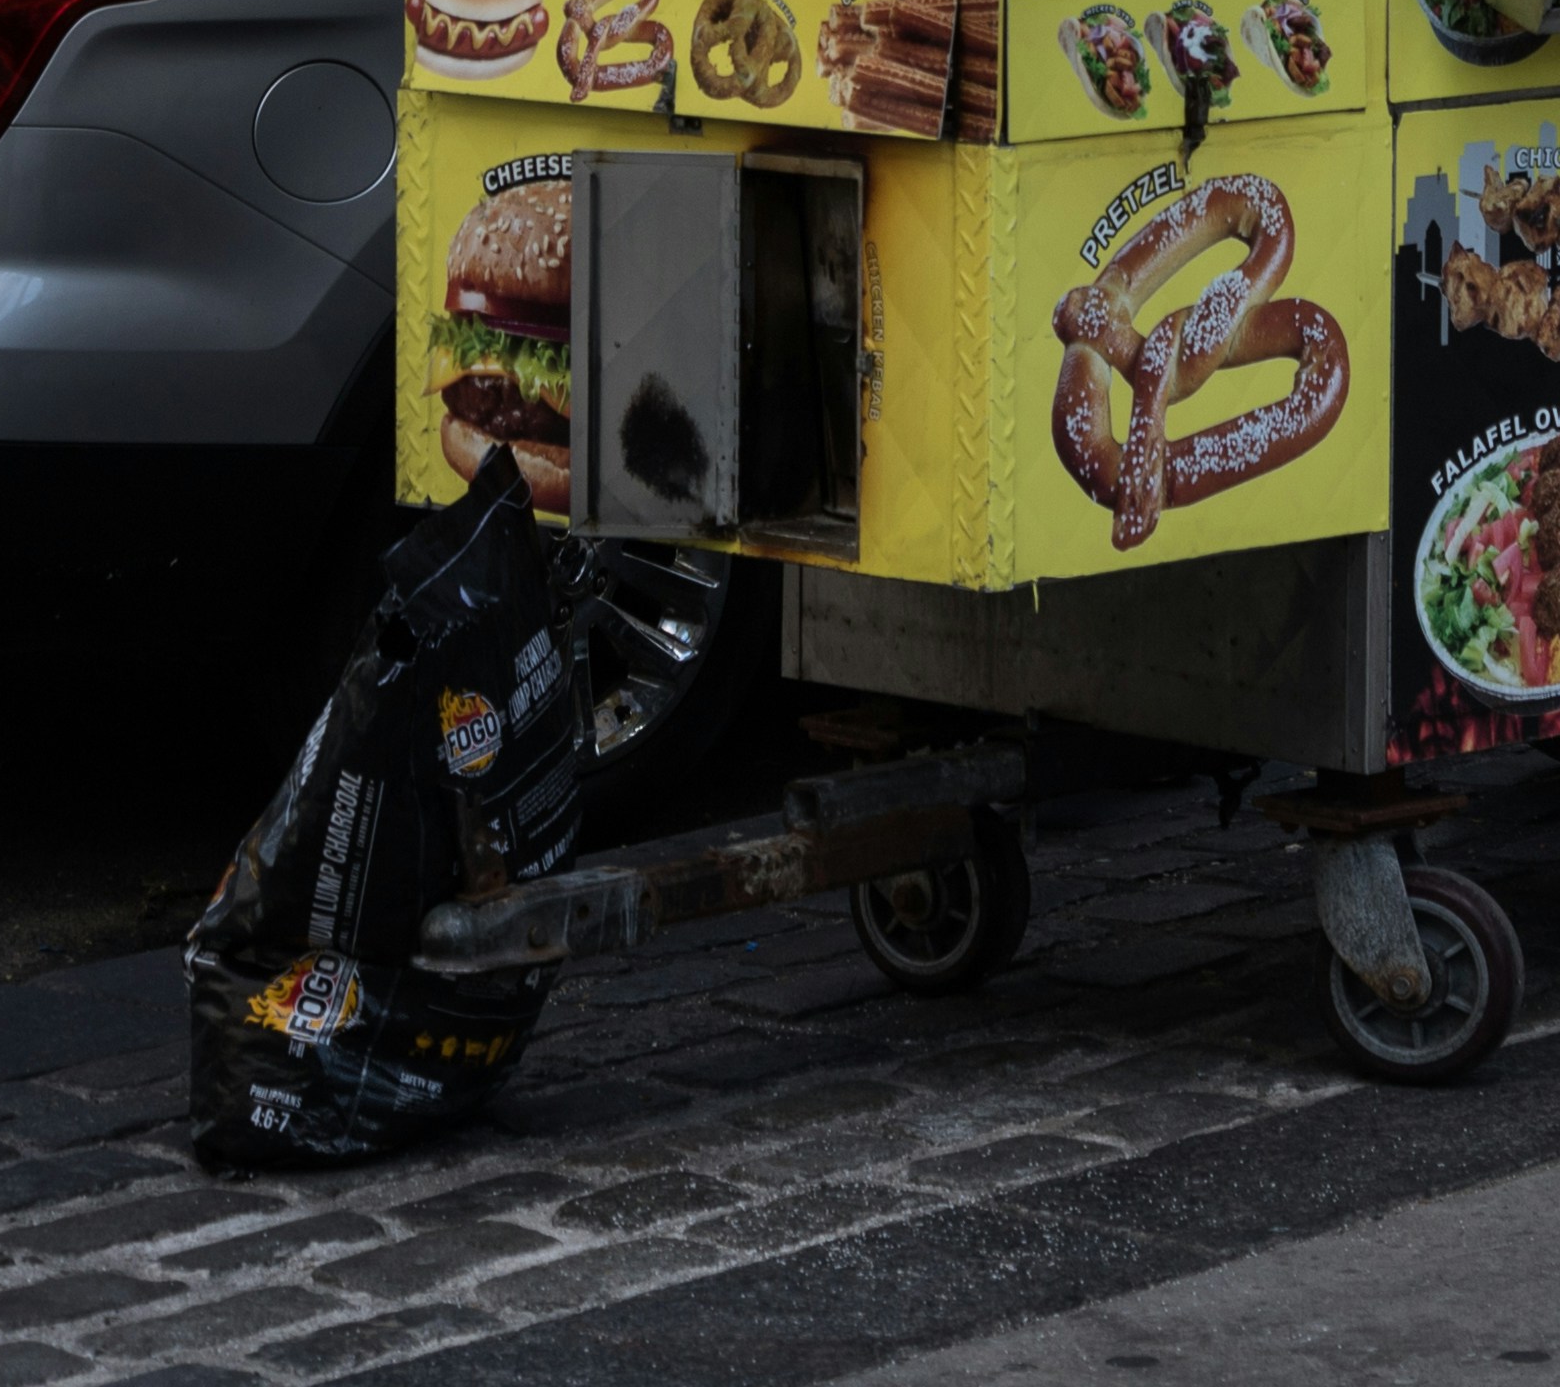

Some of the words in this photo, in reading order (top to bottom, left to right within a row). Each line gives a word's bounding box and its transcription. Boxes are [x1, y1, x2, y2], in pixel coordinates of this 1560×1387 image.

[1081, 163, 1184, 267] PRETZEL
[864, 242, 884, 343] CHICKEN
[868, 351, 885, 421] KEBAB
[1430, 414, 1527, 494] FALAFEL
[446, 710, 499, 759] FOGO
[323, 769, 364, 865] CHARCOAL
[312, 863, 344, 913] LUMP
[293, 951, 343, 1039] FOGO
[249, 1083, 303, 1109] PHILIPPIANS
[249, 1105, 291, 1133] 4:6-7
